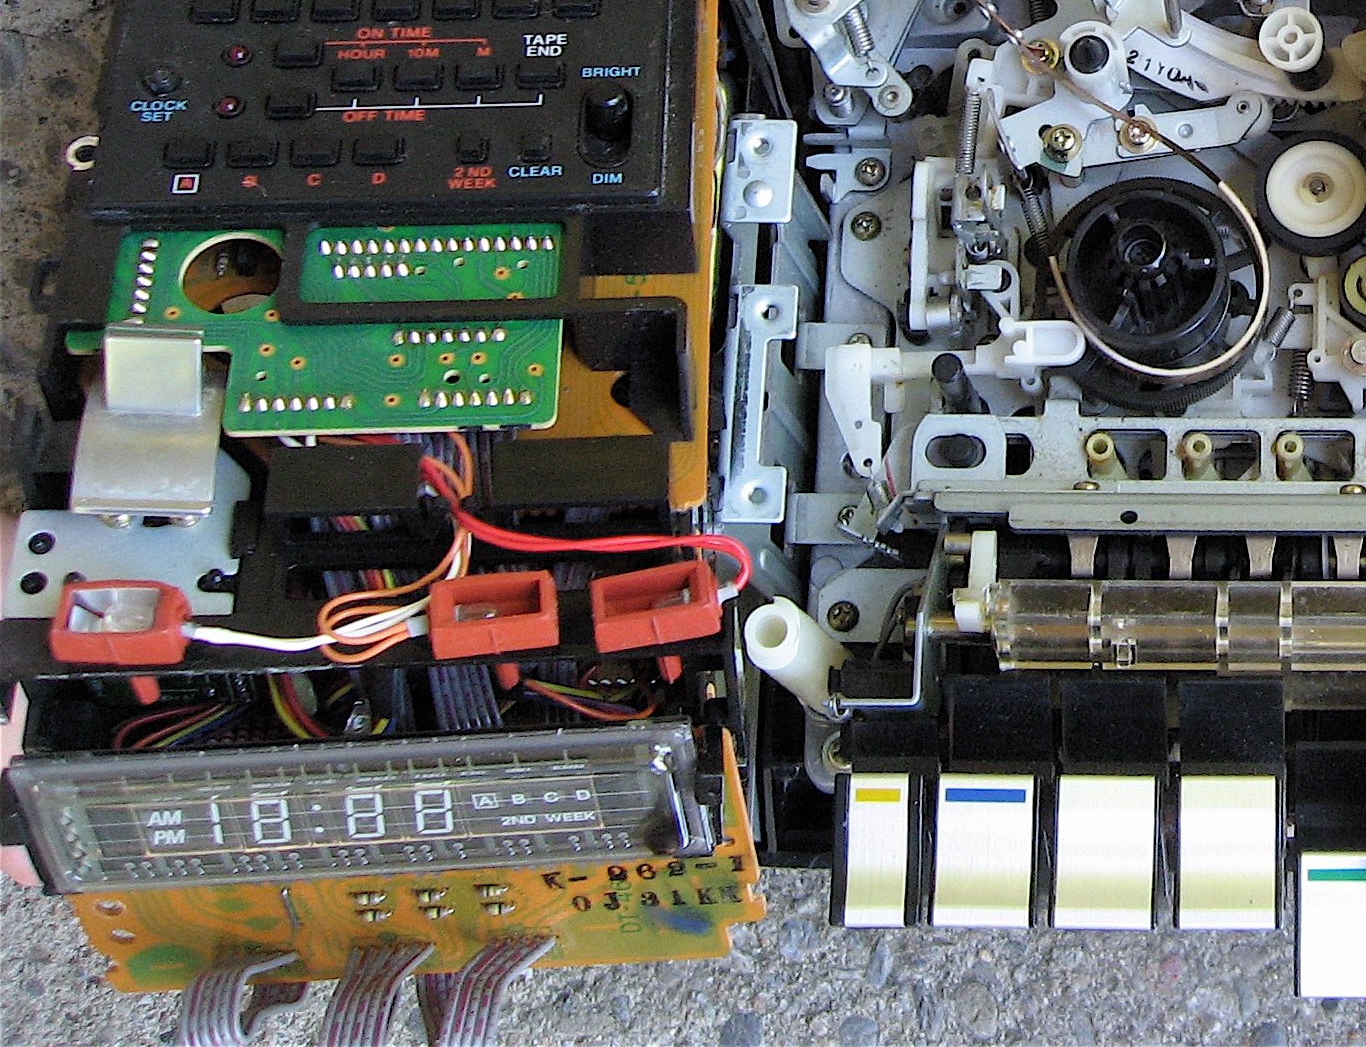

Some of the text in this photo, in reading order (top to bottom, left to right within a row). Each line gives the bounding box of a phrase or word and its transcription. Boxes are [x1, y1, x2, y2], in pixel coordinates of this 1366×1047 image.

[355, 27, 433, 40] ON TIME
[523, 34, 568, 45] TAPE
[336, 49, 387, 60] HOUR
[476, 46, 493, 57] M
[526, 45, 563, 57] END
[581, 66, 641, 78] BRIGHT
[129, 100, 189, 112] CLOCK
[140, 111, 173, 123] SET
[342, 109, 427, 123] OFF TIME
[453, 166, 493, 178] 2 ND
[508, 165, 563, 178] CLEAR
[306, 172, 323, 187] C
[371, 171, 388, 185] D
[447, 177, 497, 190] WEEK
[591, 172, 623, 185] DIM
[478, 795, 494, 806] A
[511, 794, 527, 806] B
[543, 792, 560, 803] C
[575, 789, 591, 801] D
[147, 809, 183, 827] AM
[500, 810, 596, 827] 2ND WEEK
[153, 829, 186, 845] PM
